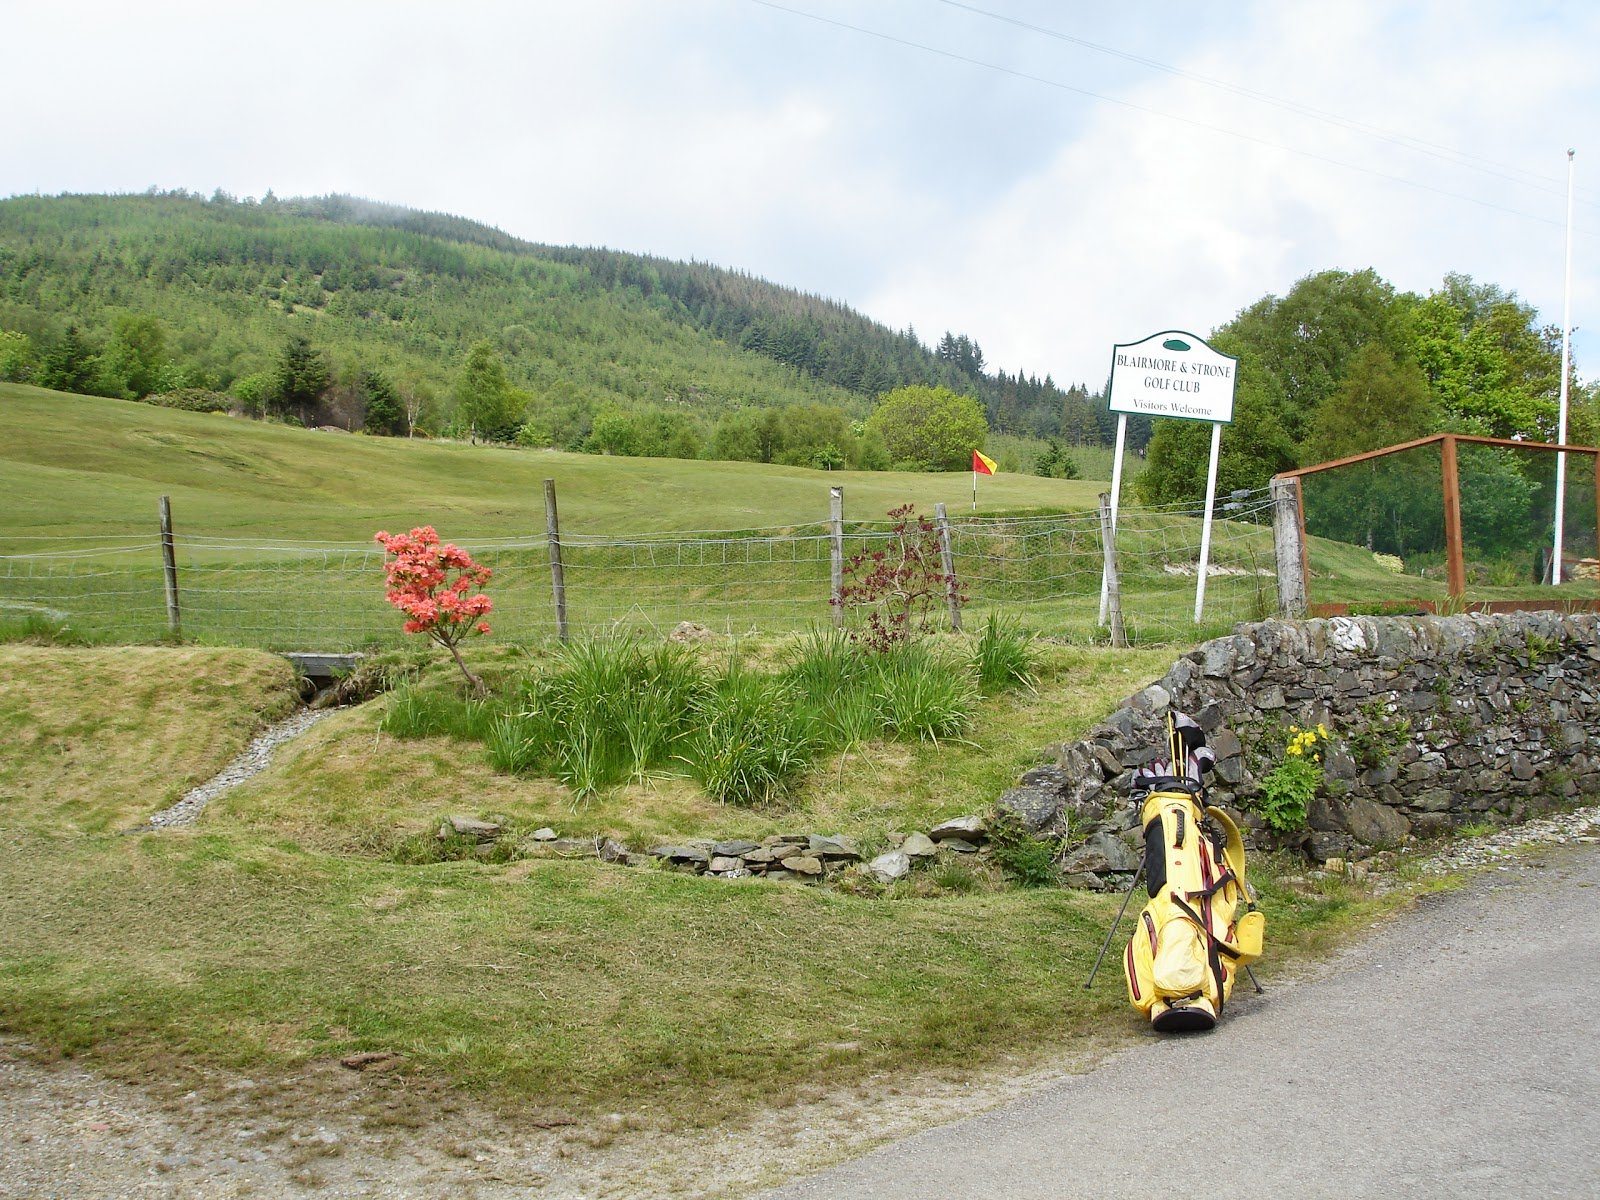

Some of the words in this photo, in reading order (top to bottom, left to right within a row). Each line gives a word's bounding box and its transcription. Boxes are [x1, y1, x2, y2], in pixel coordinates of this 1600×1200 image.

[1117, 354, 1177, 372] BLAIRMORE
[1180, 362, 1188, 373] &
[1191, 363, 1231, 378] STRONE
[1144, 376, 1171, 390] GOLF
[1173, 380, 1200, 393] CLUB
[1133, 399, 1168, 411] Visitors
[1171, 403, 1212, 415] Welcome
